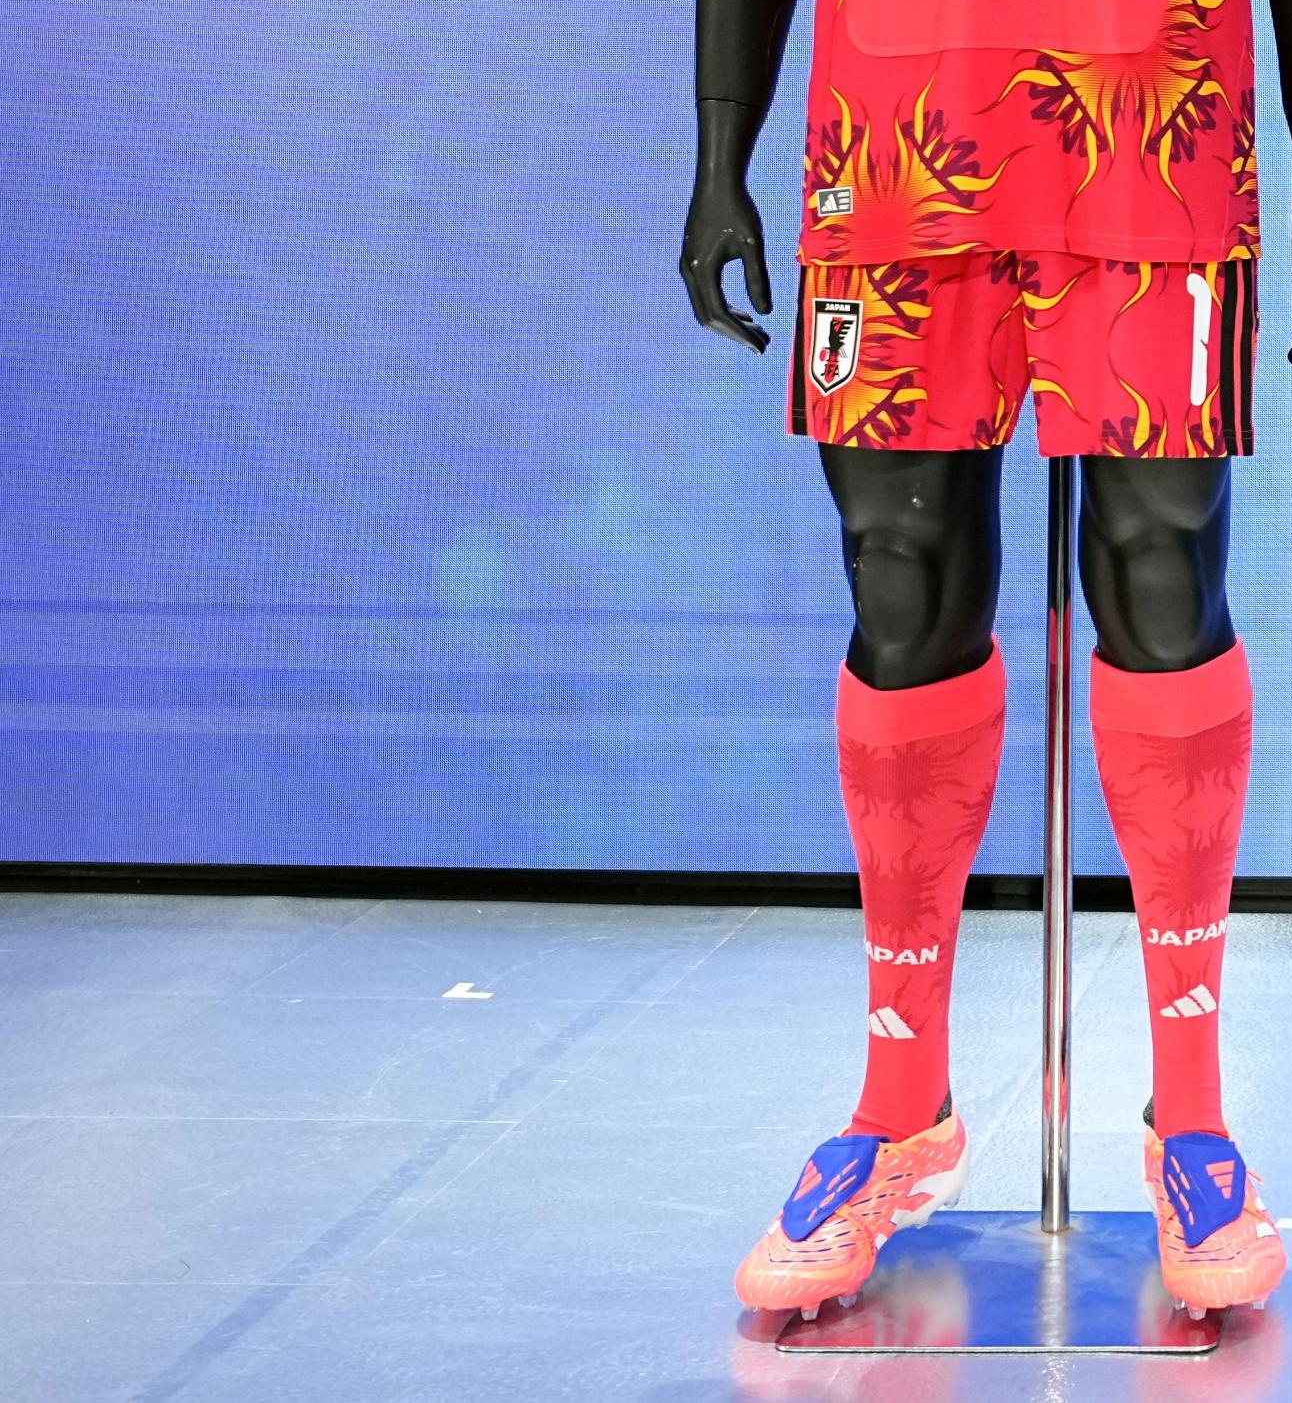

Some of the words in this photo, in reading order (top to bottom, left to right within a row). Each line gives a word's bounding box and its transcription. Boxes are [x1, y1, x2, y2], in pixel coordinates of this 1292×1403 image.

[824, 303, 851, 312] JAPAN
[1186, 272, 1212, 407] 1
[820, 363, 840, 378] JFA
[1147, 916, 1228, 947] JAPAN
[866, 941, 939, 965] APAN
